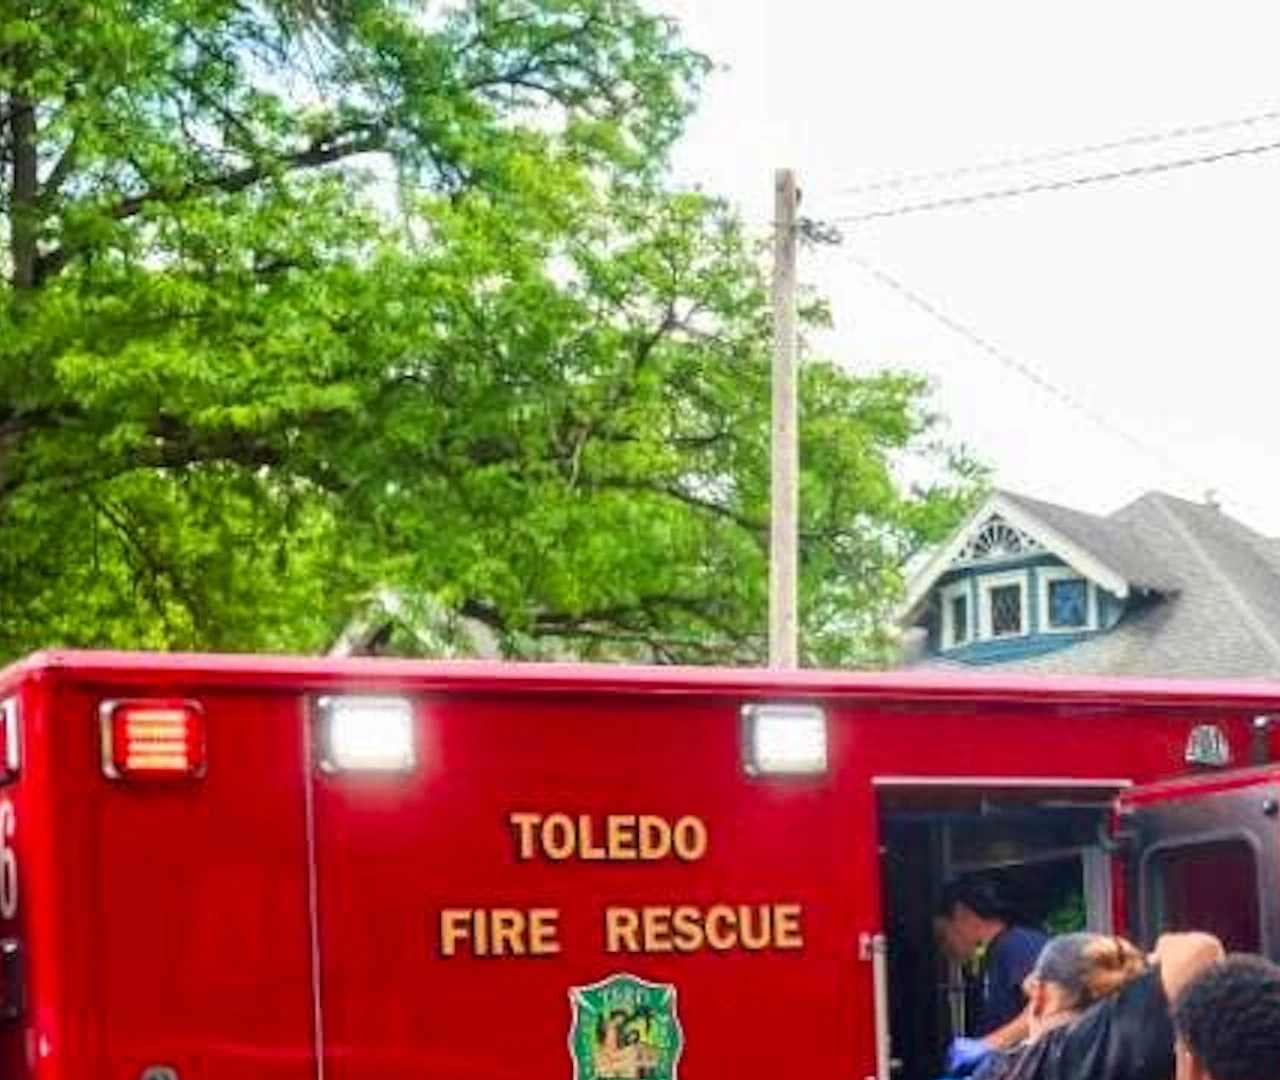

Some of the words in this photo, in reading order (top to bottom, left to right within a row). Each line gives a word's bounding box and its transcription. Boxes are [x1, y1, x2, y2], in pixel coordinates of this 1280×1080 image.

[508, 812, 708, 861] TOLEDO
[439, 908, 561, 956] FIRE
[605, 903, 804, 952] RESCUE
